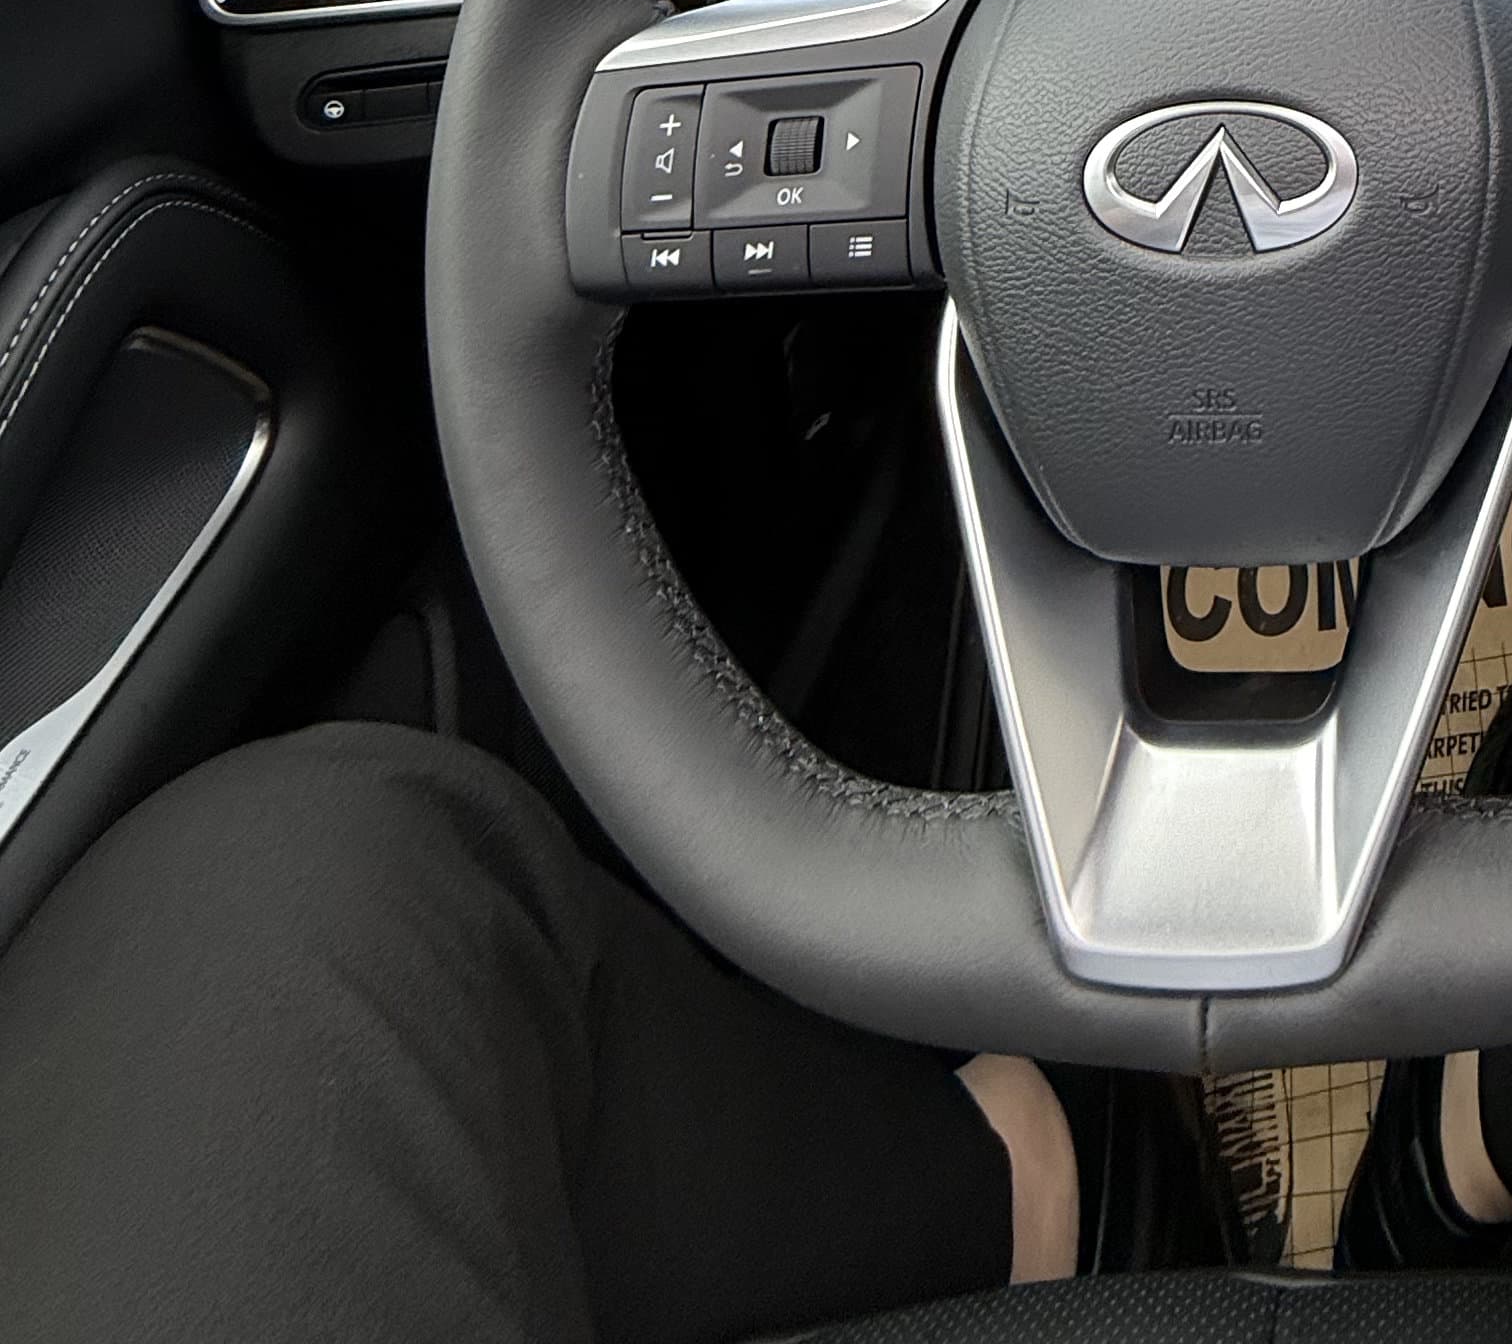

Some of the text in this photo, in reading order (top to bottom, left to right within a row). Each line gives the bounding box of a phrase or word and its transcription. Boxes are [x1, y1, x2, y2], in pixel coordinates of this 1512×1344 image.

[776, 187, 804, 206] OK
[1190, 387, 1237, 413] SRS
[1167, 419, 1264, 446] AIRBAG
